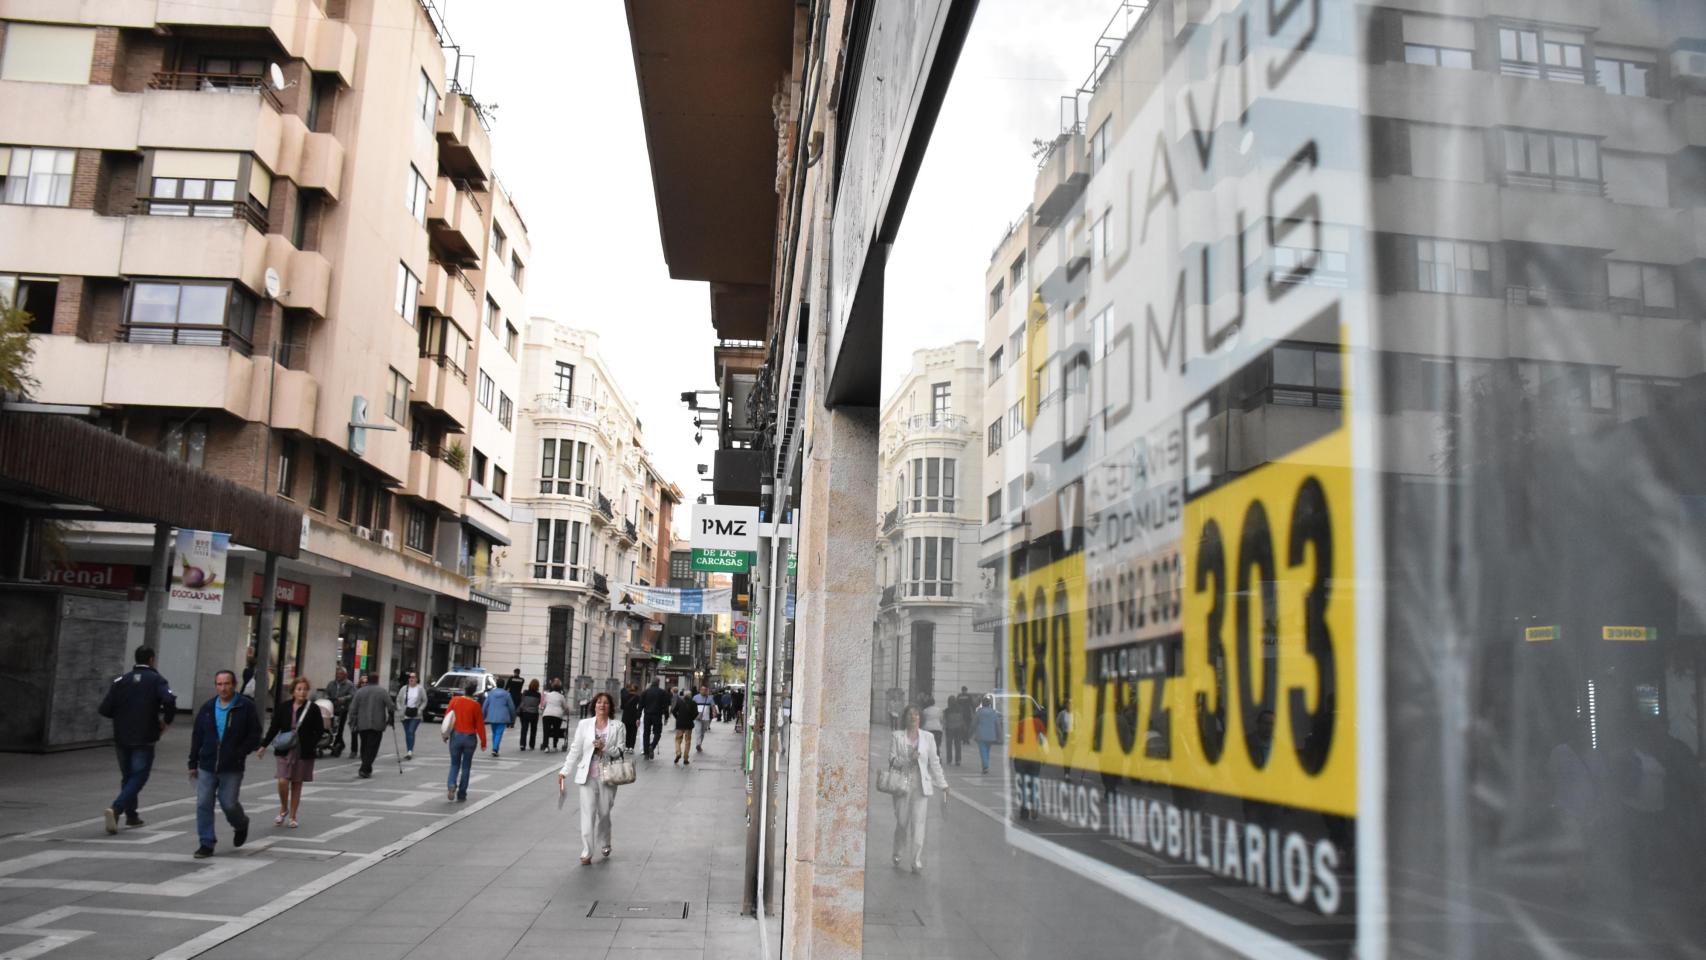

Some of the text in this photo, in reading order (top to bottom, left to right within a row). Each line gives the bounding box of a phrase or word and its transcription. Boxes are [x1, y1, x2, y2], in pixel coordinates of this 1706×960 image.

[1062, 138, 1321, 462] DOMUS
[1106, 485, 1179, 550] DOMUS
[702, 519, 747, 536] PMZ
[696, 557, 743, 567] CARCASAS
[703, 549, 737, 558] DE LAS
[41, 566, 113, 585] arenal
[276, 585, 295, 601] enal
[1012, 576, 1072, 749] 980
[1194, 474, 1338, 778] 303
[1013, 772, 1343, 915] SERVICIOS INMOBILIARIOS
